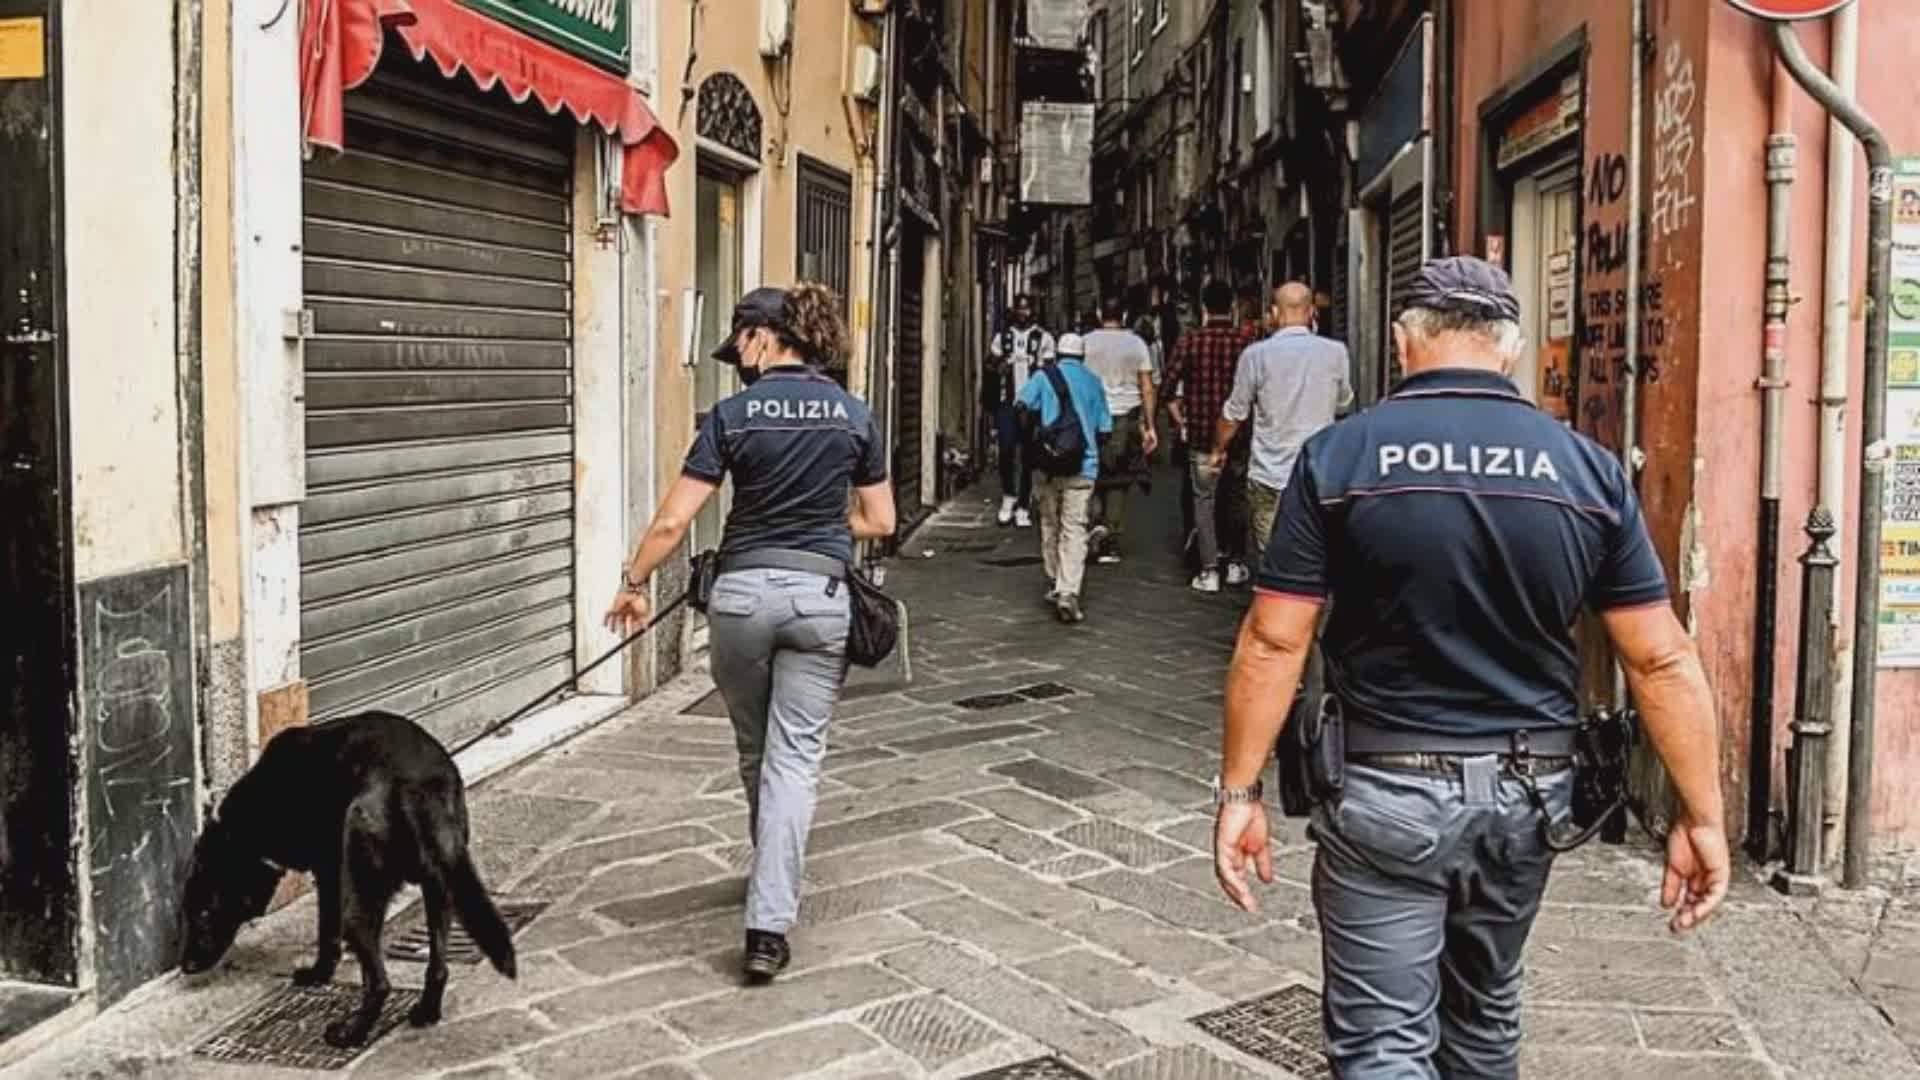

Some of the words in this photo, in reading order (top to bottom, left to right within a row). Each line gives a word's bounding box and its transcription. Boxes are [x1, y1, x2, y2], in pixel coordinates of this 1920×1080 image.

[1590, 153, 1626, 206] NO
[746, 399, 849, 419] POLIZIA
[1378, 441, 1560, 483] POLIZIA
